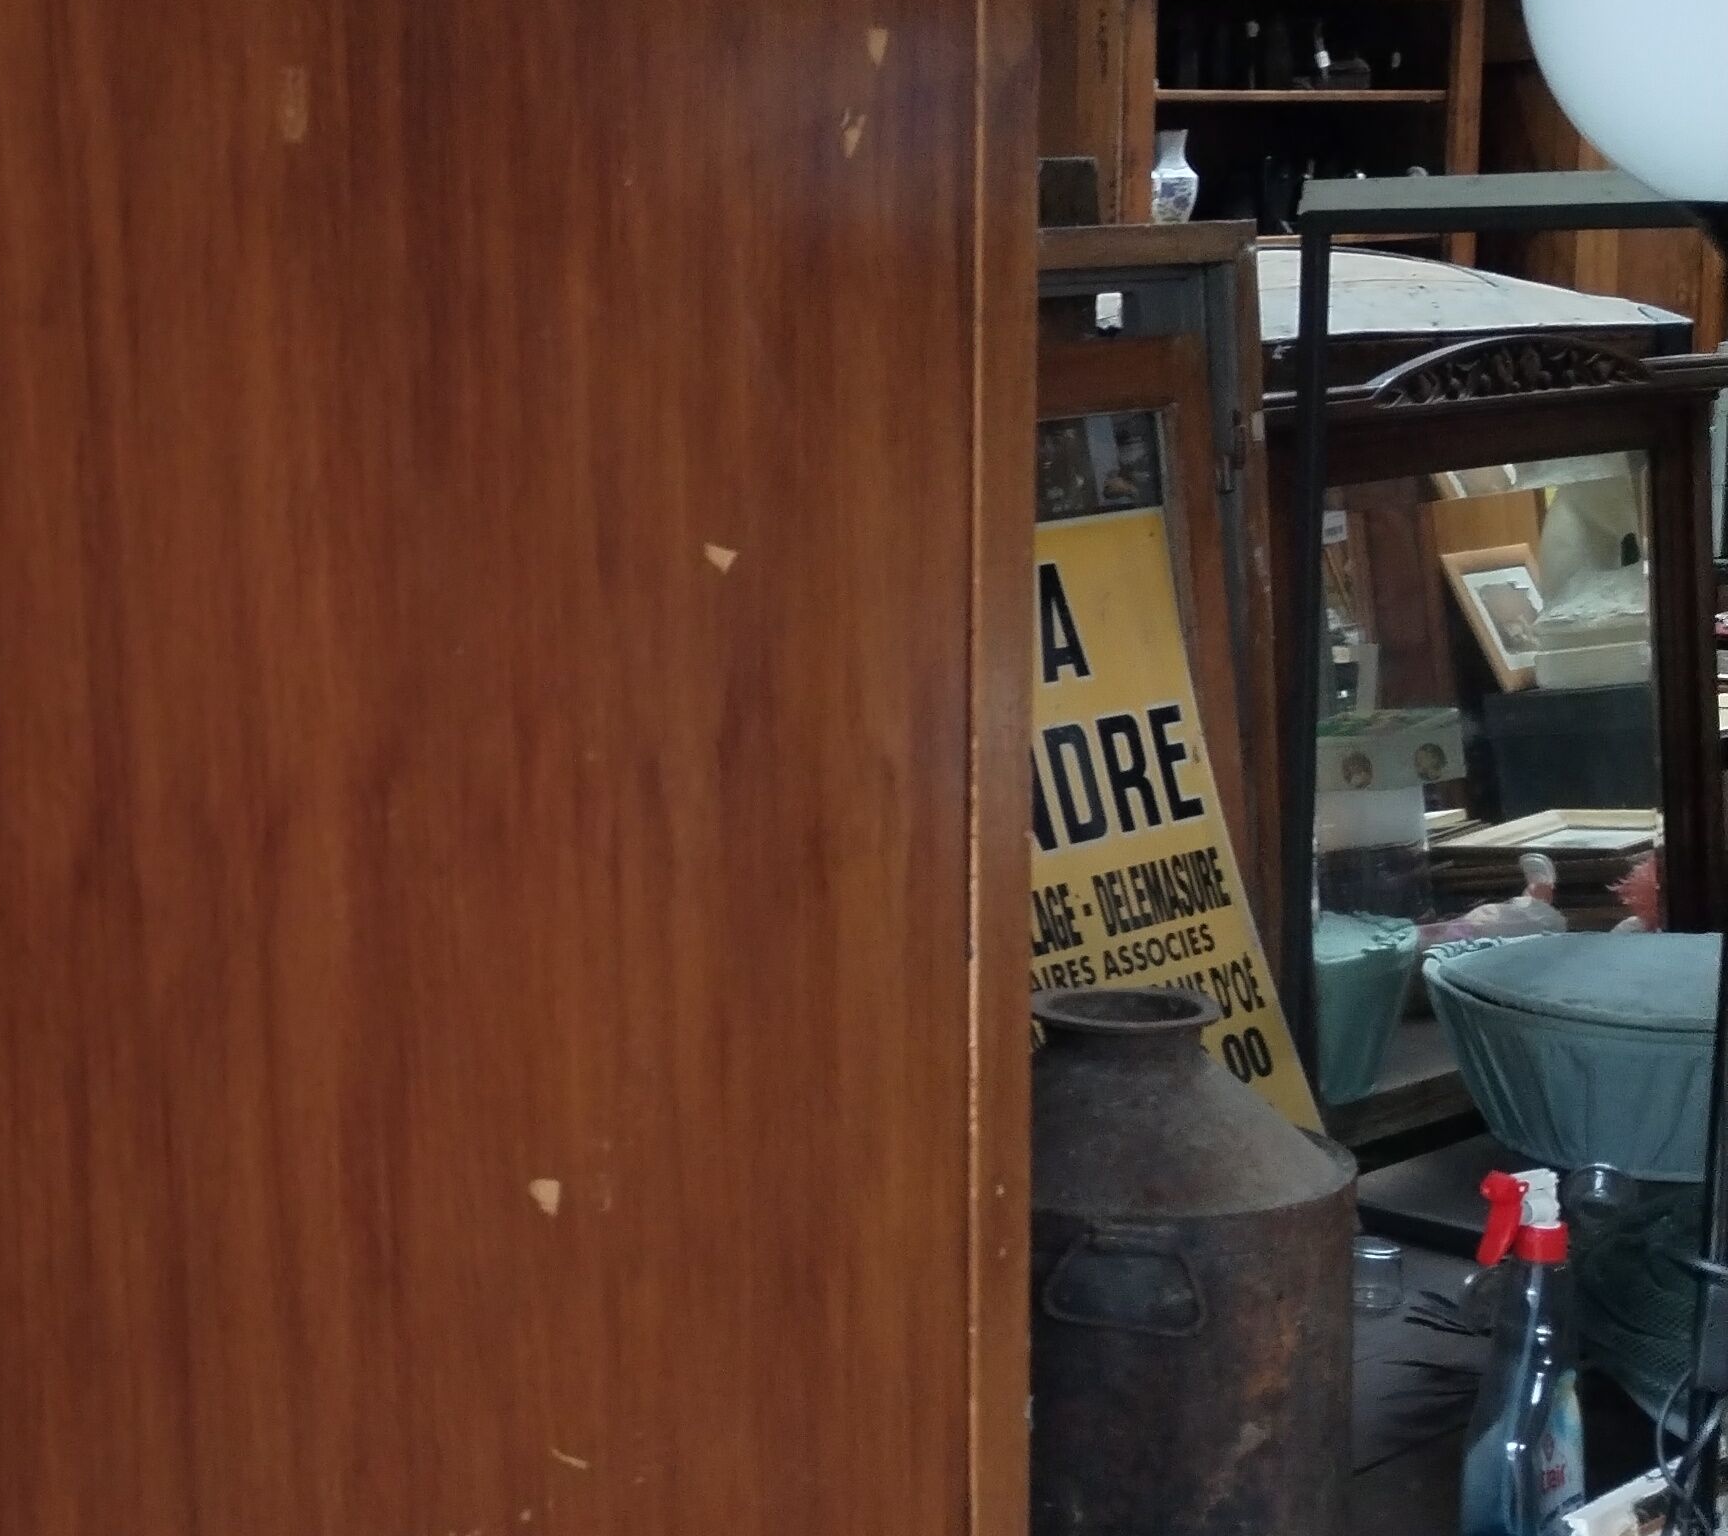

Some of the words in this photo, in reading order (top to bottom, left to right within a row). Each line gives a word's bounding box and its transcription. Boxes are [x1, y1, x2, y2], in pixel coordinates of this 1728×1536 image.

[1039, 563, 1090, 683] A
[1091, 846, 1232, 937] DELEMASURE
[1103, 923, 1216, 980] ASSOCIES
